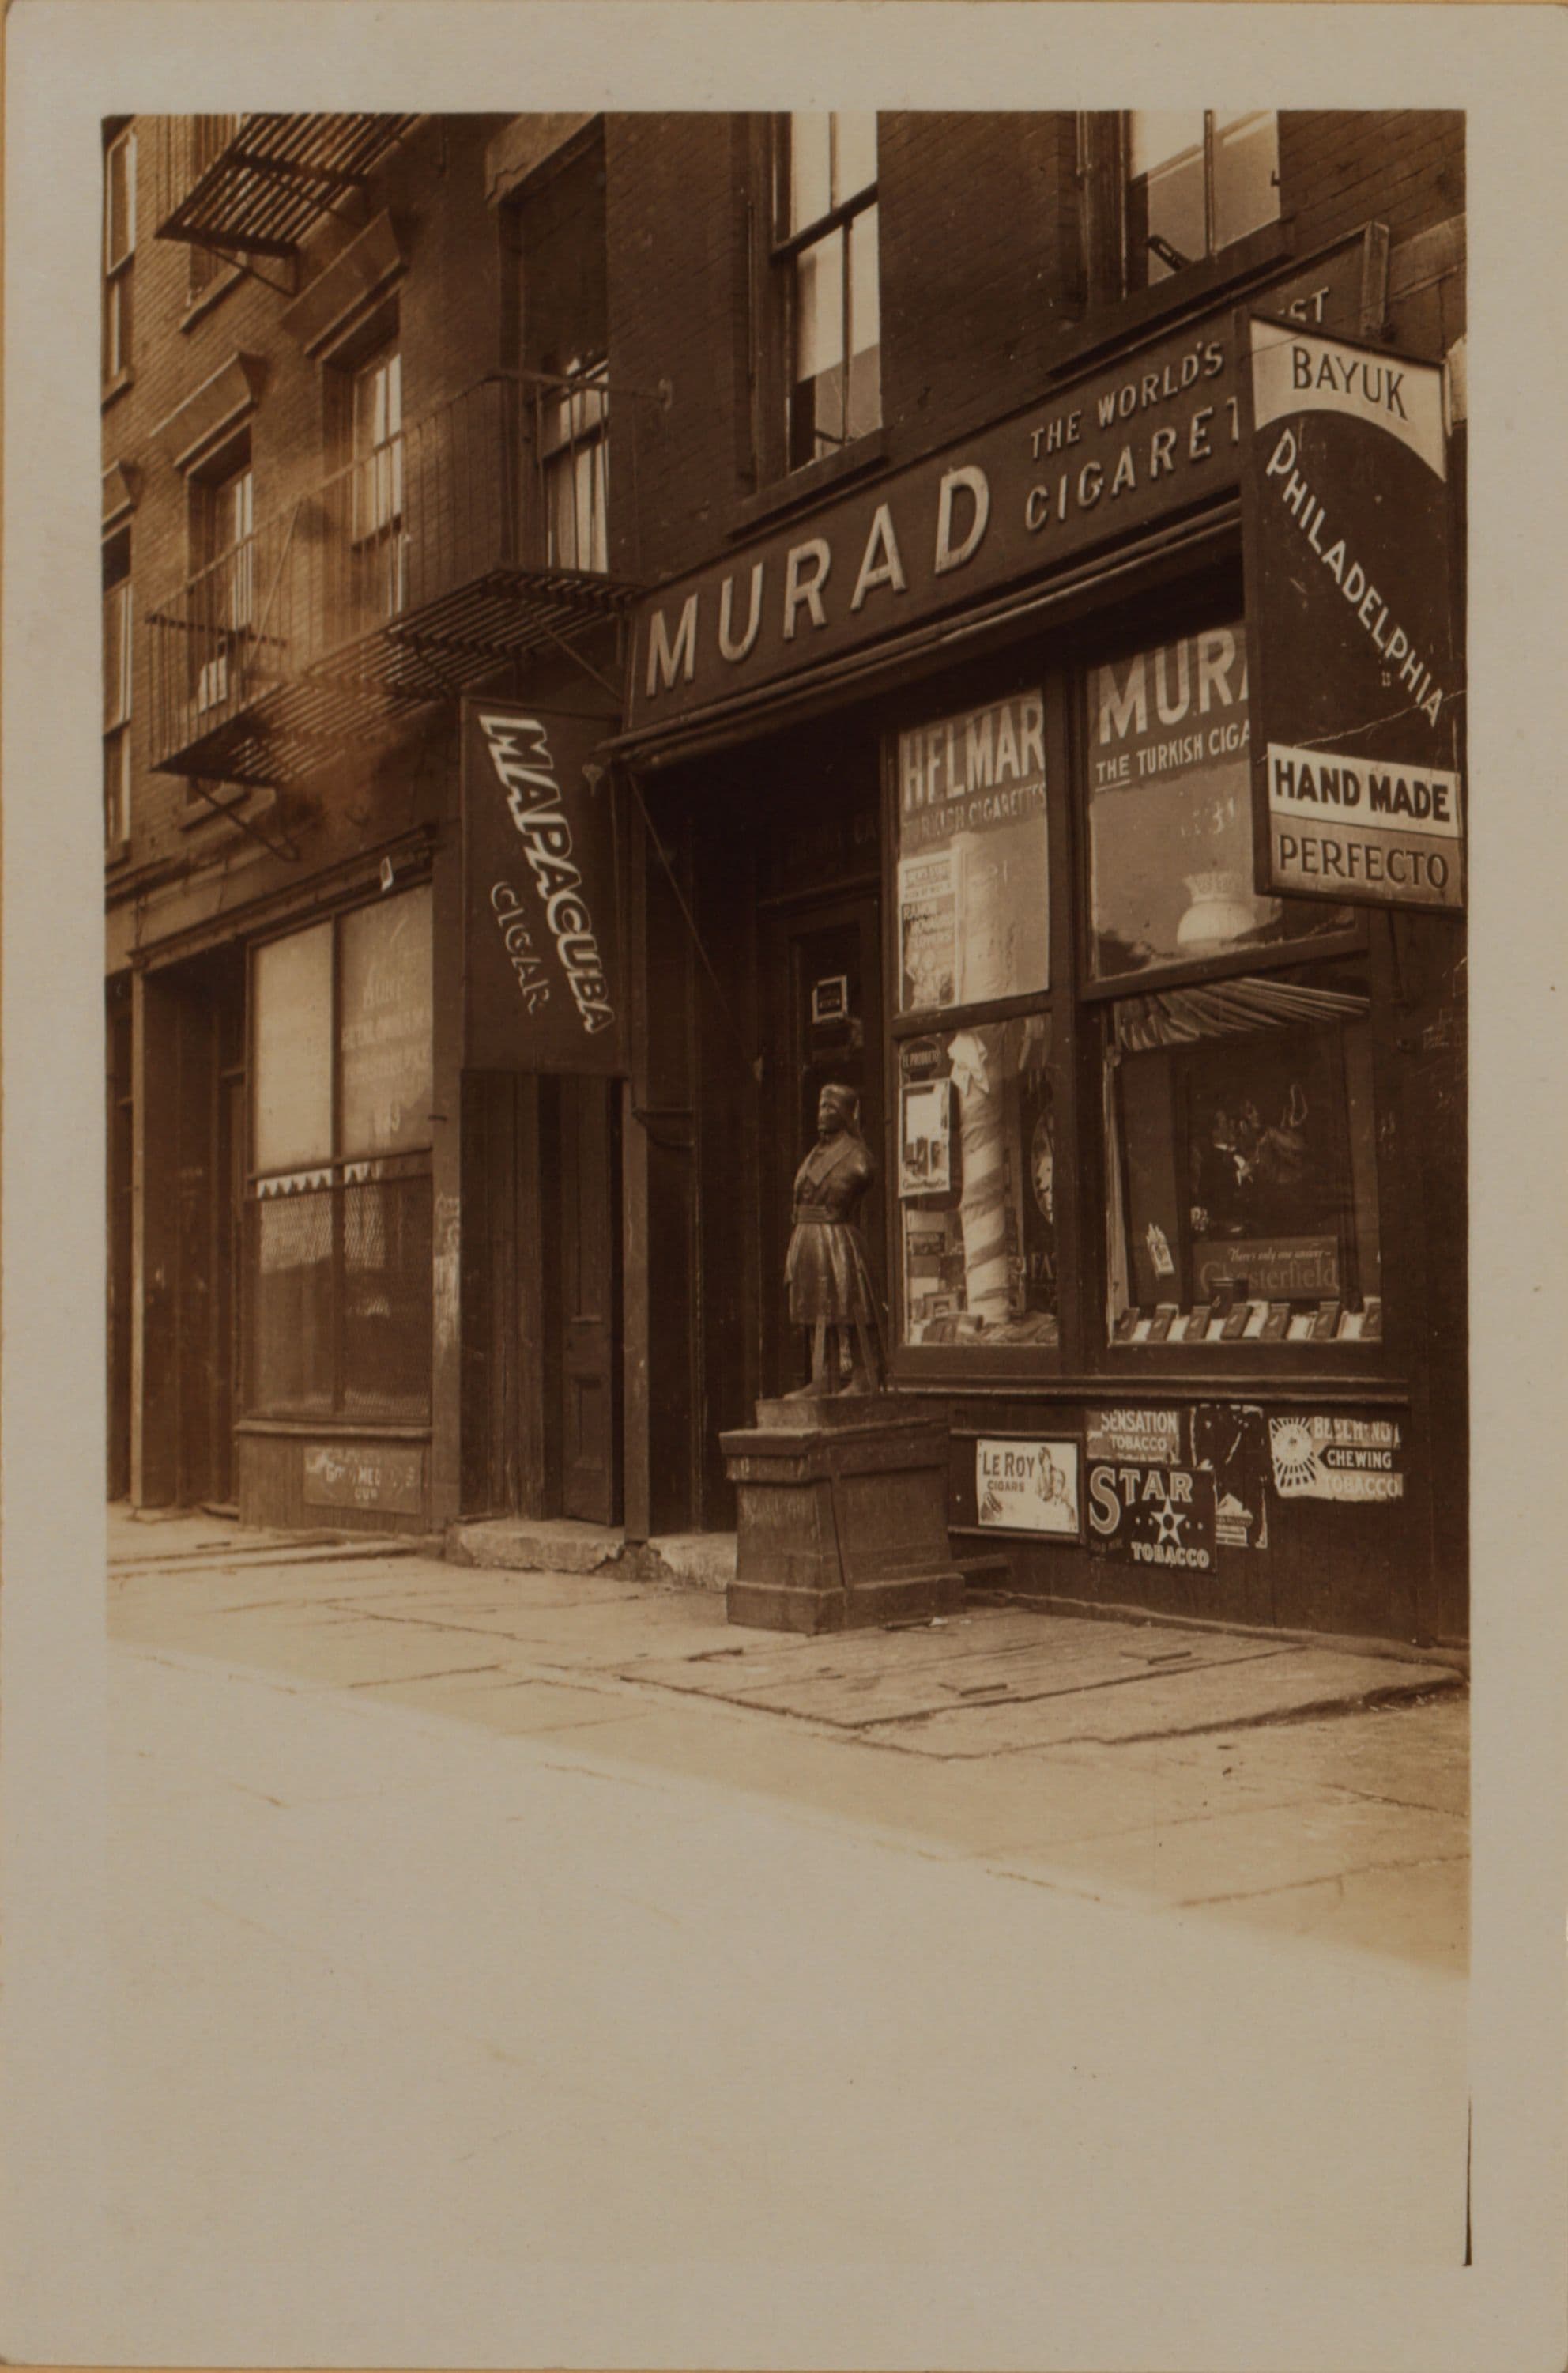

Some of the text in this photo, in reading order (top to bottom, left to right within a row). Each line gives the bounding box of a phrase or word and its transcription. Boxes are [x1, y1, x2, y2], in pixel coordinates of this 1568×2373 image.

[1030, 287, 1329, 459] THE WORLD'S ST
[1292, 346, 1408, 421] BAYUK
[645, 463, 991, 699] MURAD
[1266, 428, 1444, 727] PHILADELPHIA
[1095, 755, 1130, 783] THE
[1136, 733, 1203, 775] TURKISH
[1274, 759, 1451, 822] HAND MADE
[479, 715, 616, 1034] MAPACUBA
[1279, 834, 1449, 889] PERFECTO
[489, 881, 550, 1015] CIGAR
[1100, 1409, 1178, 1434] SENSATION
[1110, 1435, 1167, 1451] TOBACCO
[982, 1451, 1035, 1478] LE ROY
[1324, 1474, 1398, 1497] TOBACCO
[1327, 1448, 1393, 1469] CHEWING
[987, 1480, 1025, 1493] CIGARS
[1089, 1465, 1193, 1535] STAR
[1131, 1541, 1210, 1568] TOBACCO
